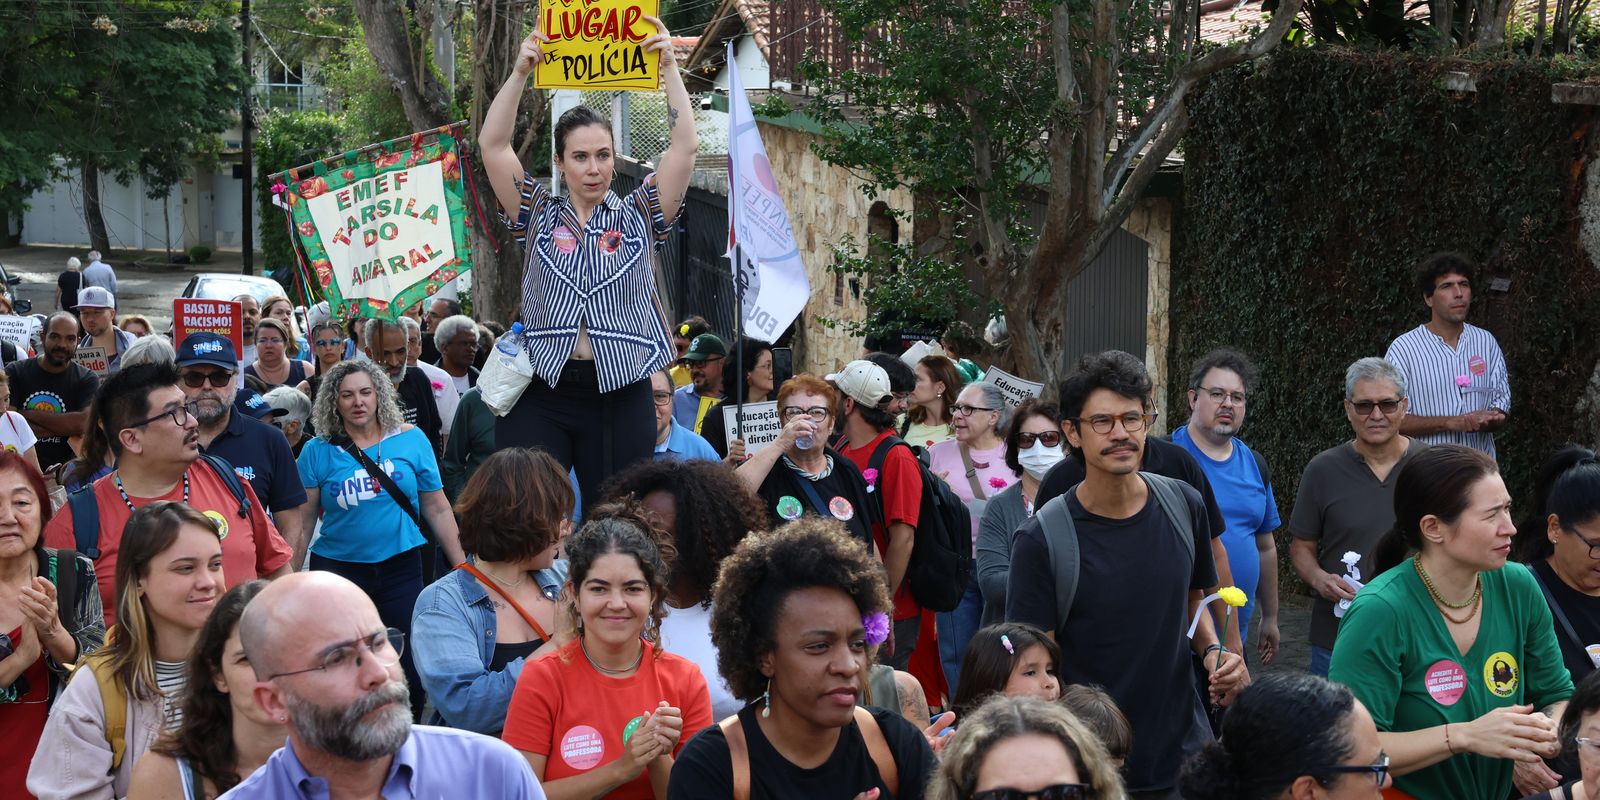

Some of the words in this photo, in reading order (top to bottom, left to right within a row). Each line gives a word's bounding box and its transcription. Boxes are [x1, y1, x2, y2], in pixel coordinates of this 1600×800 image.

[546, 6, 648, 43] LUGAR
[543, 50, 561, 65] DE
[561, 44, 648, 81] POLÍCIA
[336, 171, 408, 212] EMEF
[332, 197, 439, 246] TARSILA
[363, 222, 399, 248] DO
[352, 244, 443, 286] AMARAL
[183, 303, 215, 314] BASTA
[218, 304, 232, 314] DE
[183, 316, 232, 327] RACISMO!
[731, 421, 781, 435] atirracist
[329, 470, 404, 498] SINEP
